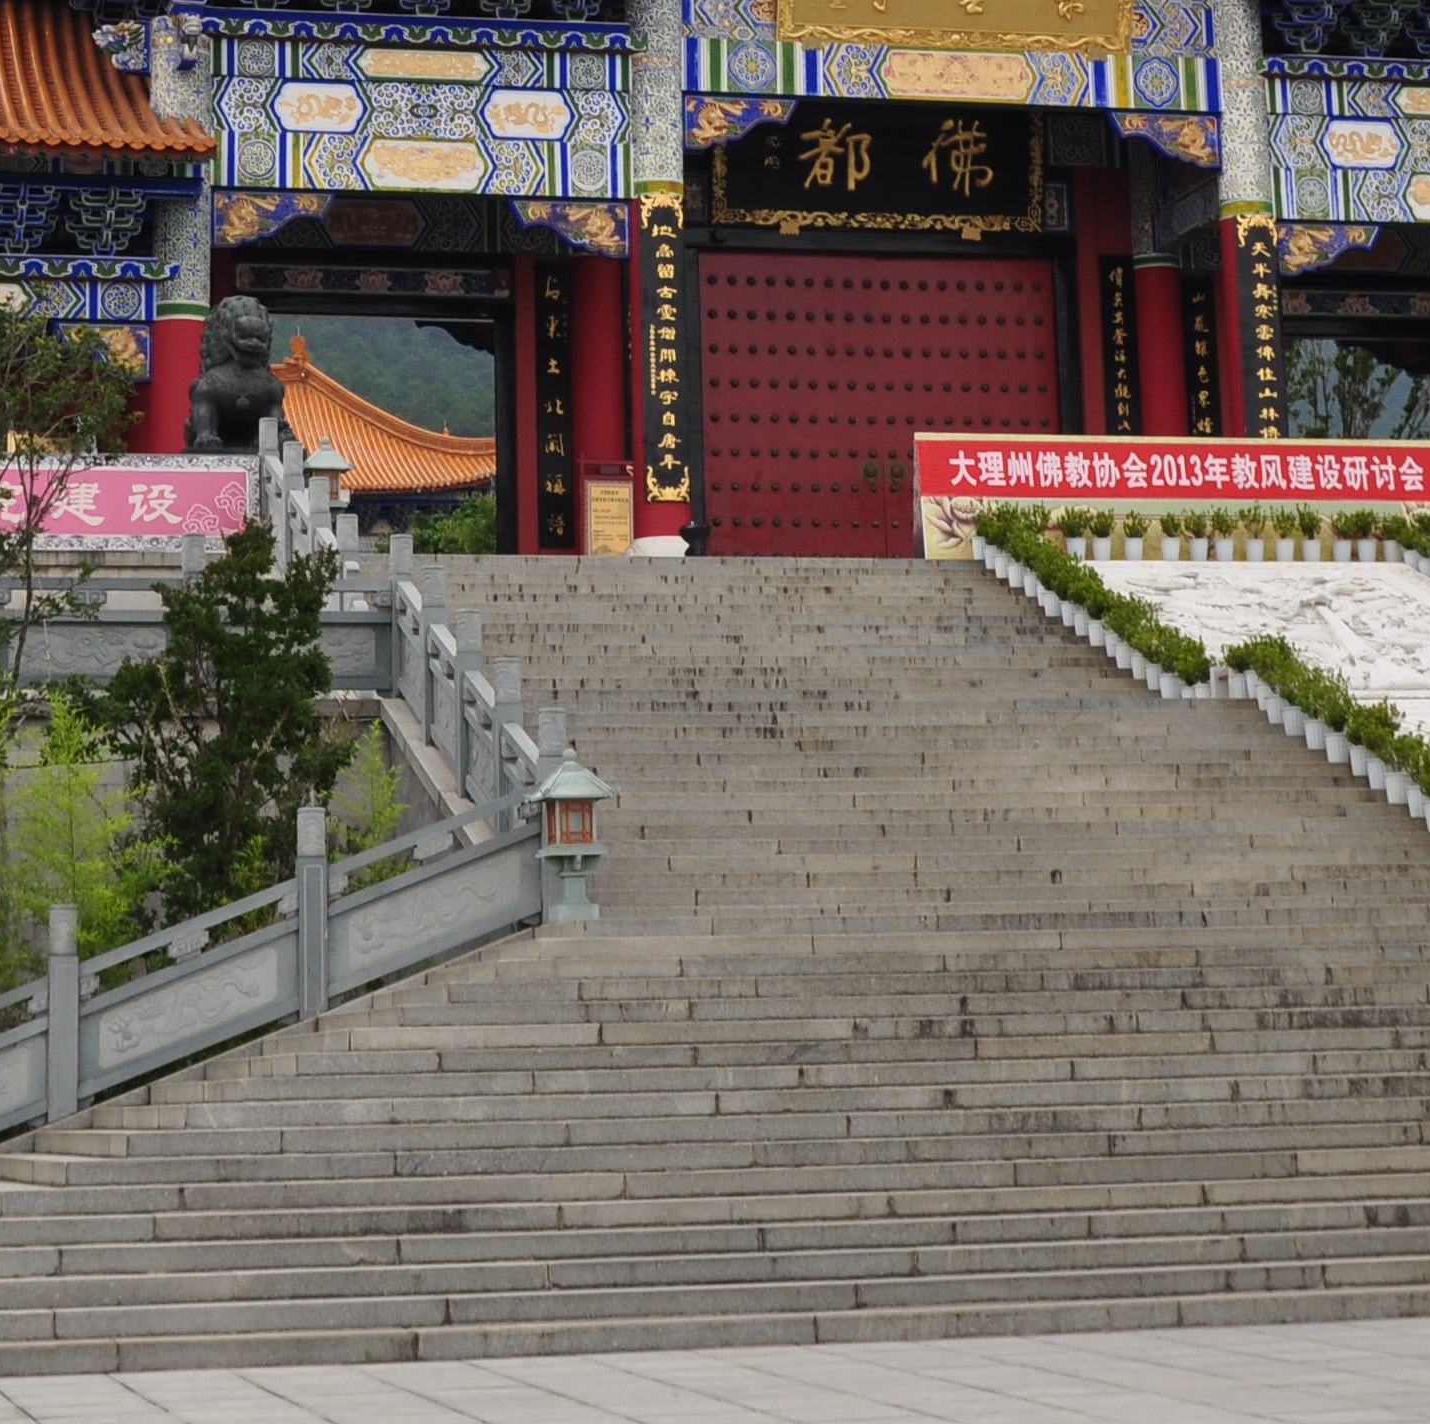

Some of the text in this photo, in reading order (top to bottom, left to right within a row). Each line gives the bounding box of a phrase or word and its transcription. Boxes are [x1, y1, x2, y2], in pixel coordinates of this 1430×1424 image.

[948, 449, 1426, 493] 大理州佛教协会2013年教风建设研讨会
